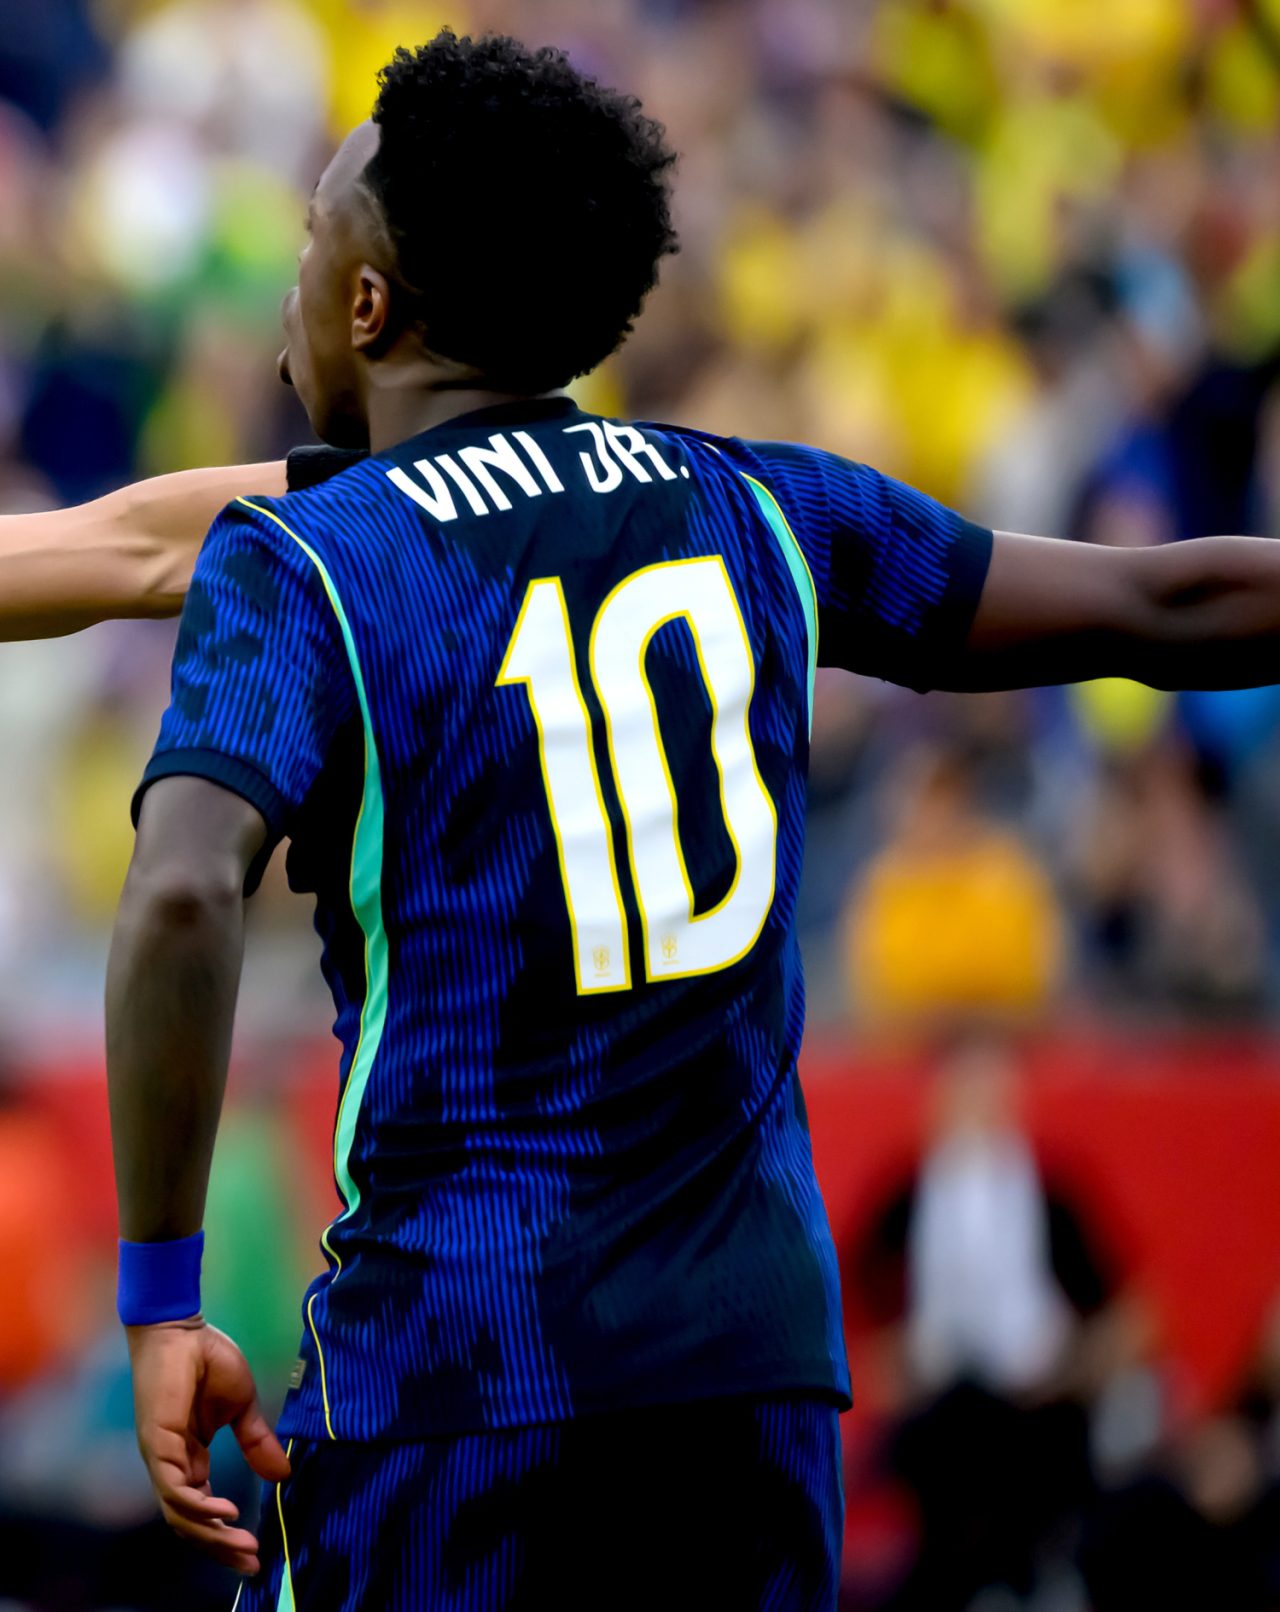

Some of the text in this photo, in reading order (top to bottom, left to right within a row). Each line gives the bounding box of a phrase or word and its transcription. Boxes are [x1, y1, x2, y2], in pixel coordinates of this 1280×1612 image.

[385, 419, 690, 523] VINI JR.
[494, 554, 779, 997] 10
